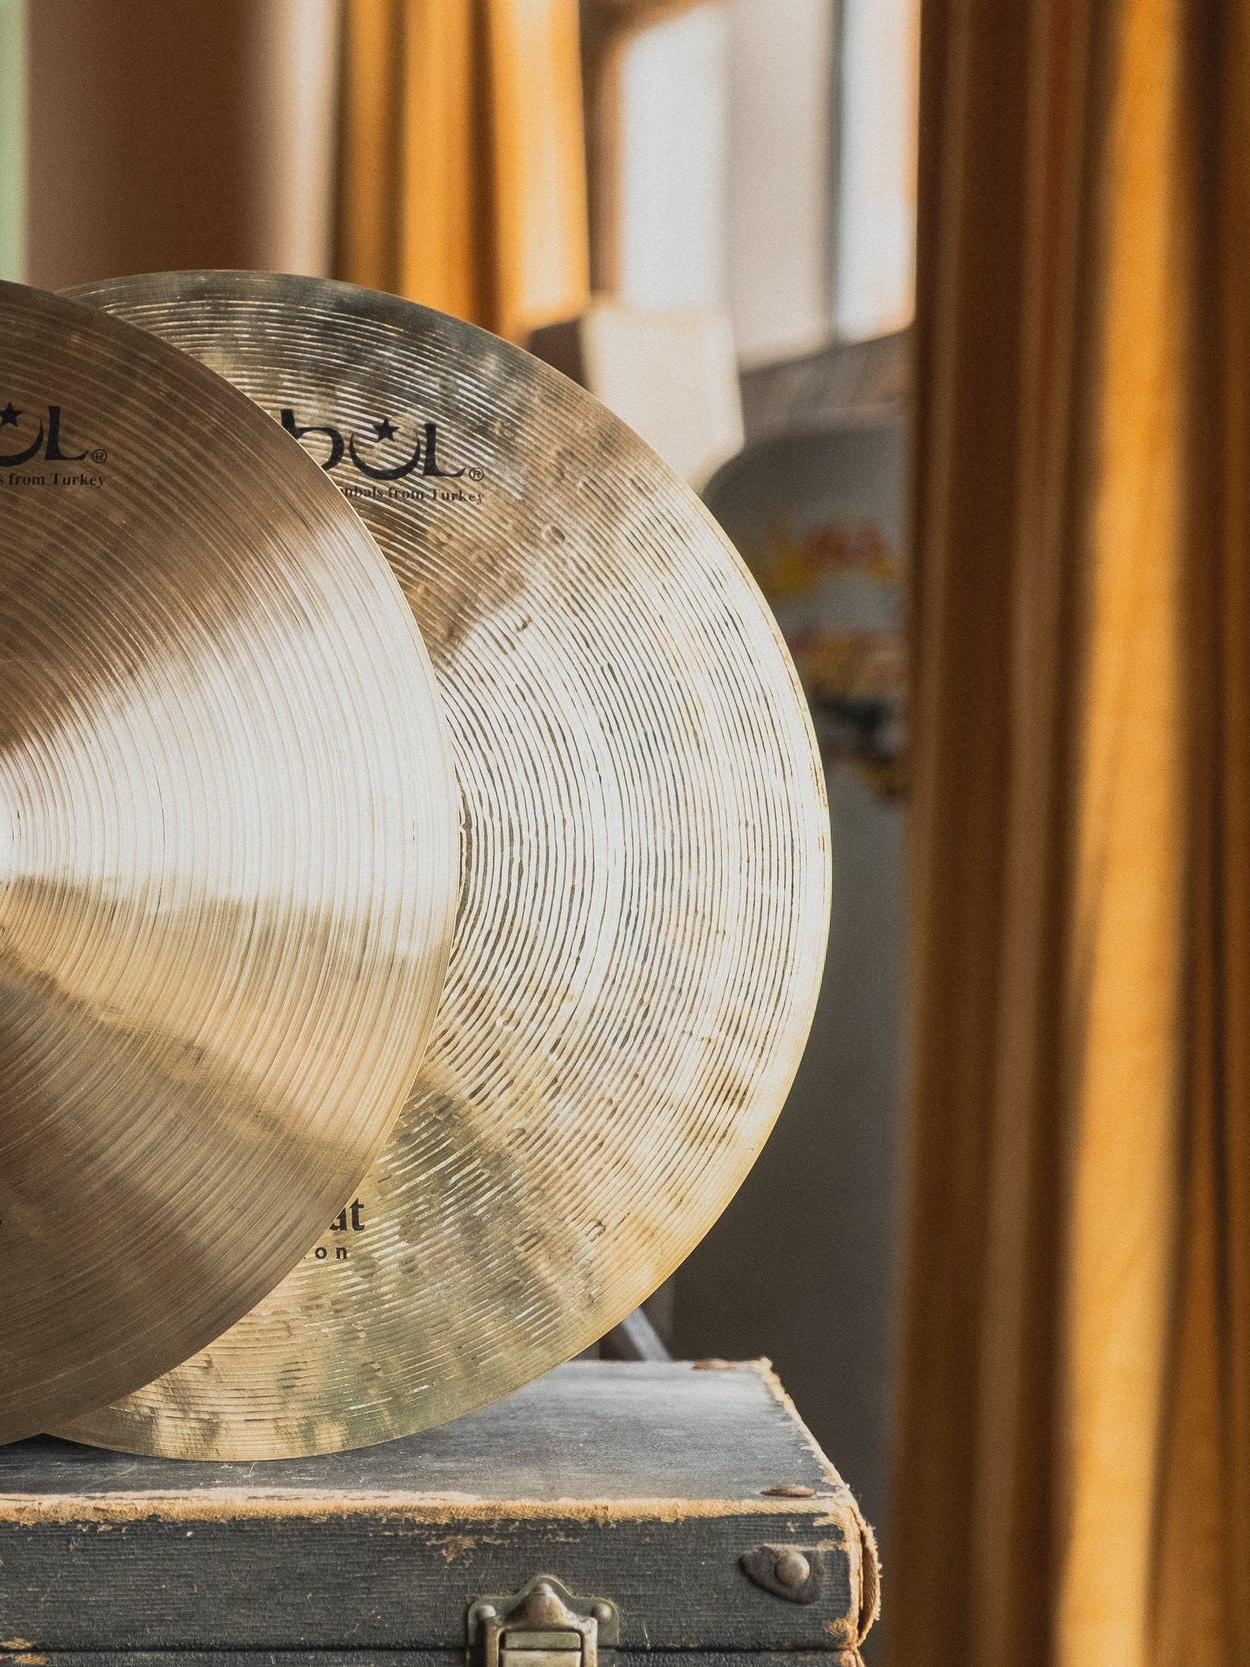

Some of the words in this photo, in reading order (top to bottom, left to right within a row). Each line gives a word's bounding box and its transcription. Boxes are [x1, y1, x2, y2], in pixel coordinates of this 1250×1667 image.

[8, 473, 45, 486] from
[52, 473, 105, 488] Turkey
[388, 487, 424, 500] from
[431, 488, 483, 504] Turkey
